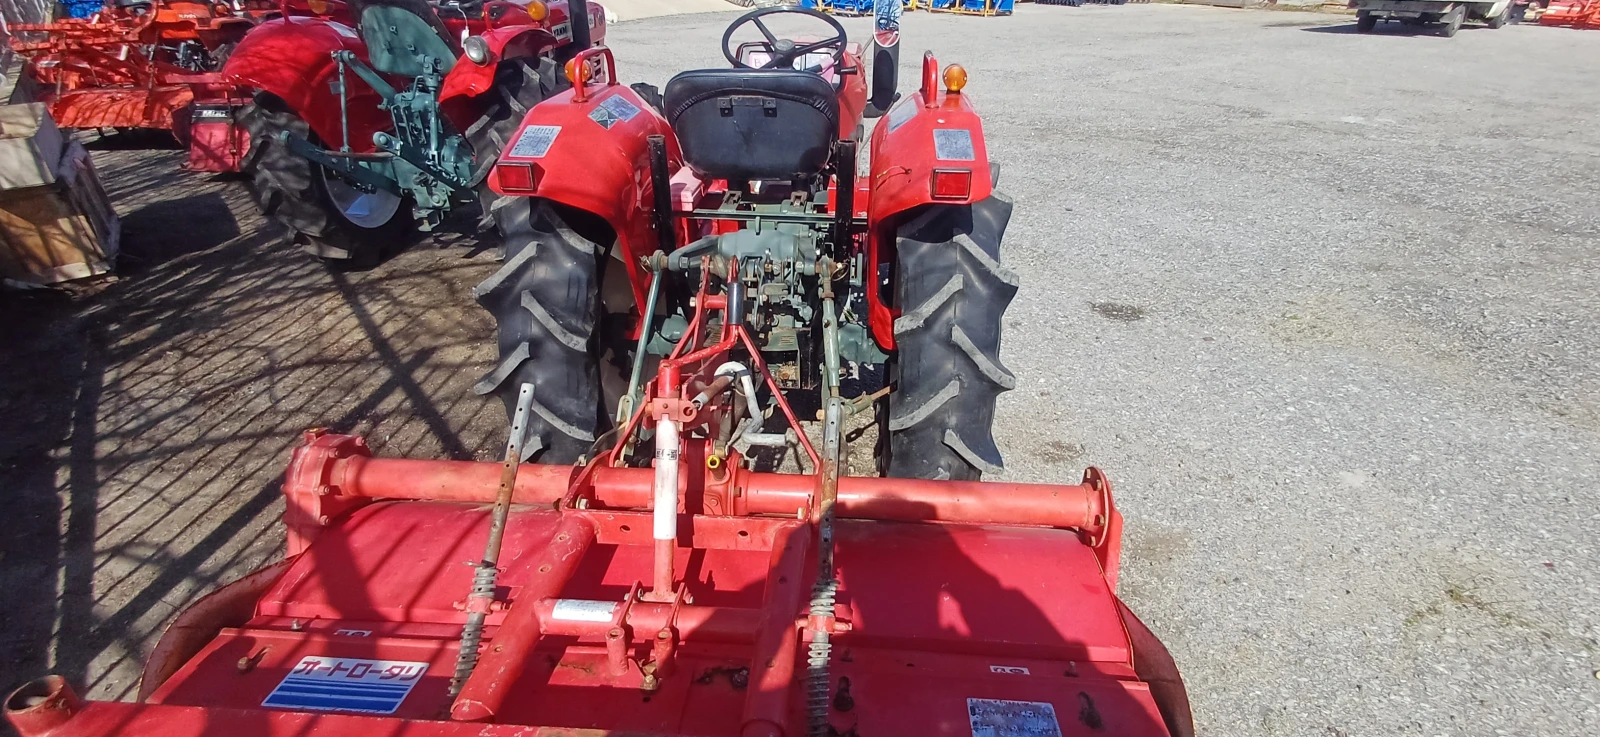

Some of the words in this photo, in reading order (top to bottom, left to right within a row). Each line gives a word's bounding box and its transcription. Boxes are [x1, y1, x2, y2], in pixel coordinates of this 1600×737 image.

[553, 25, 568, 37] YANM
[292, 660, 425, 681] オートロータリ
